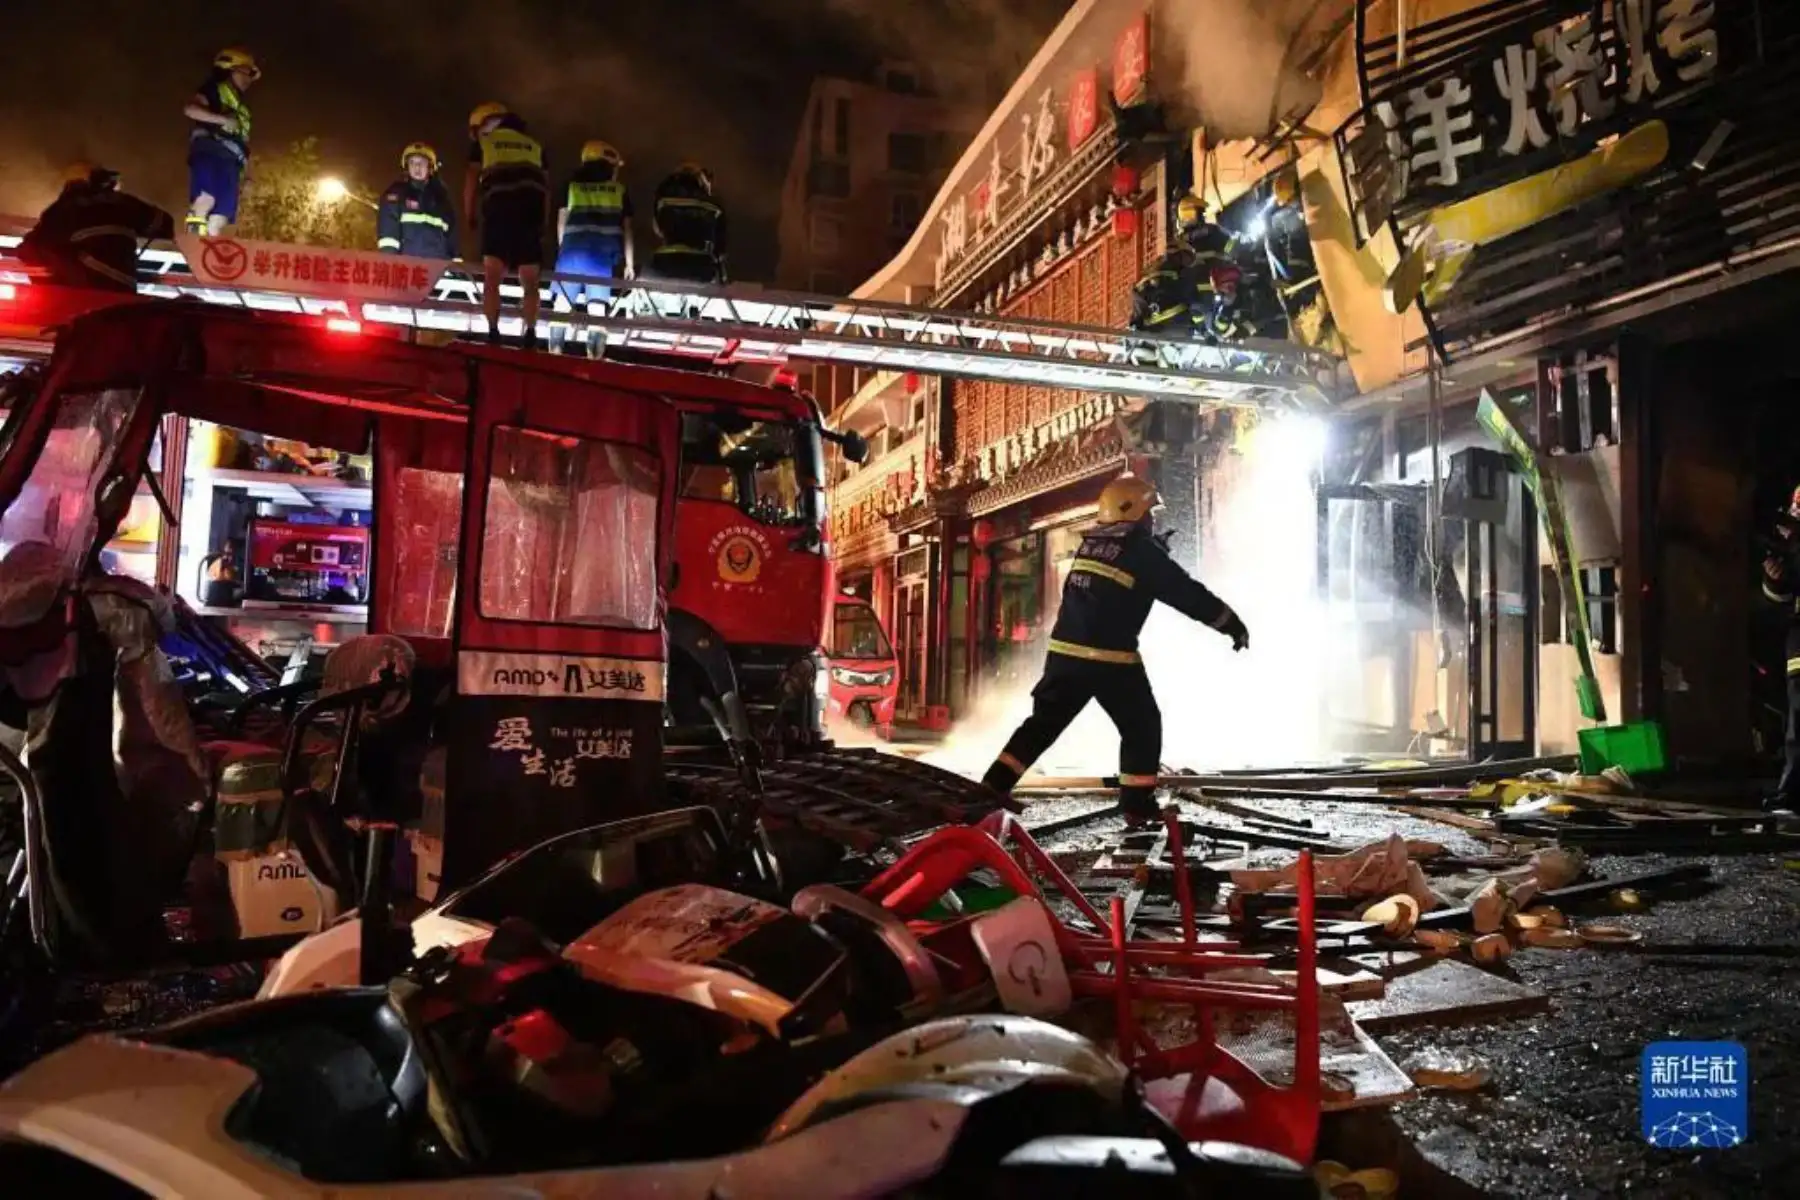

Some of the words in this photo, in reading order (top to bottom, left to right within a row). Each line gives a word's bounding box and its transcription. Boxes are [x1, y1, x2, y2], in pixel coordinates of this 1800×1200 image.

[253, 249, 429, 291] 举升抢险主战消防车
